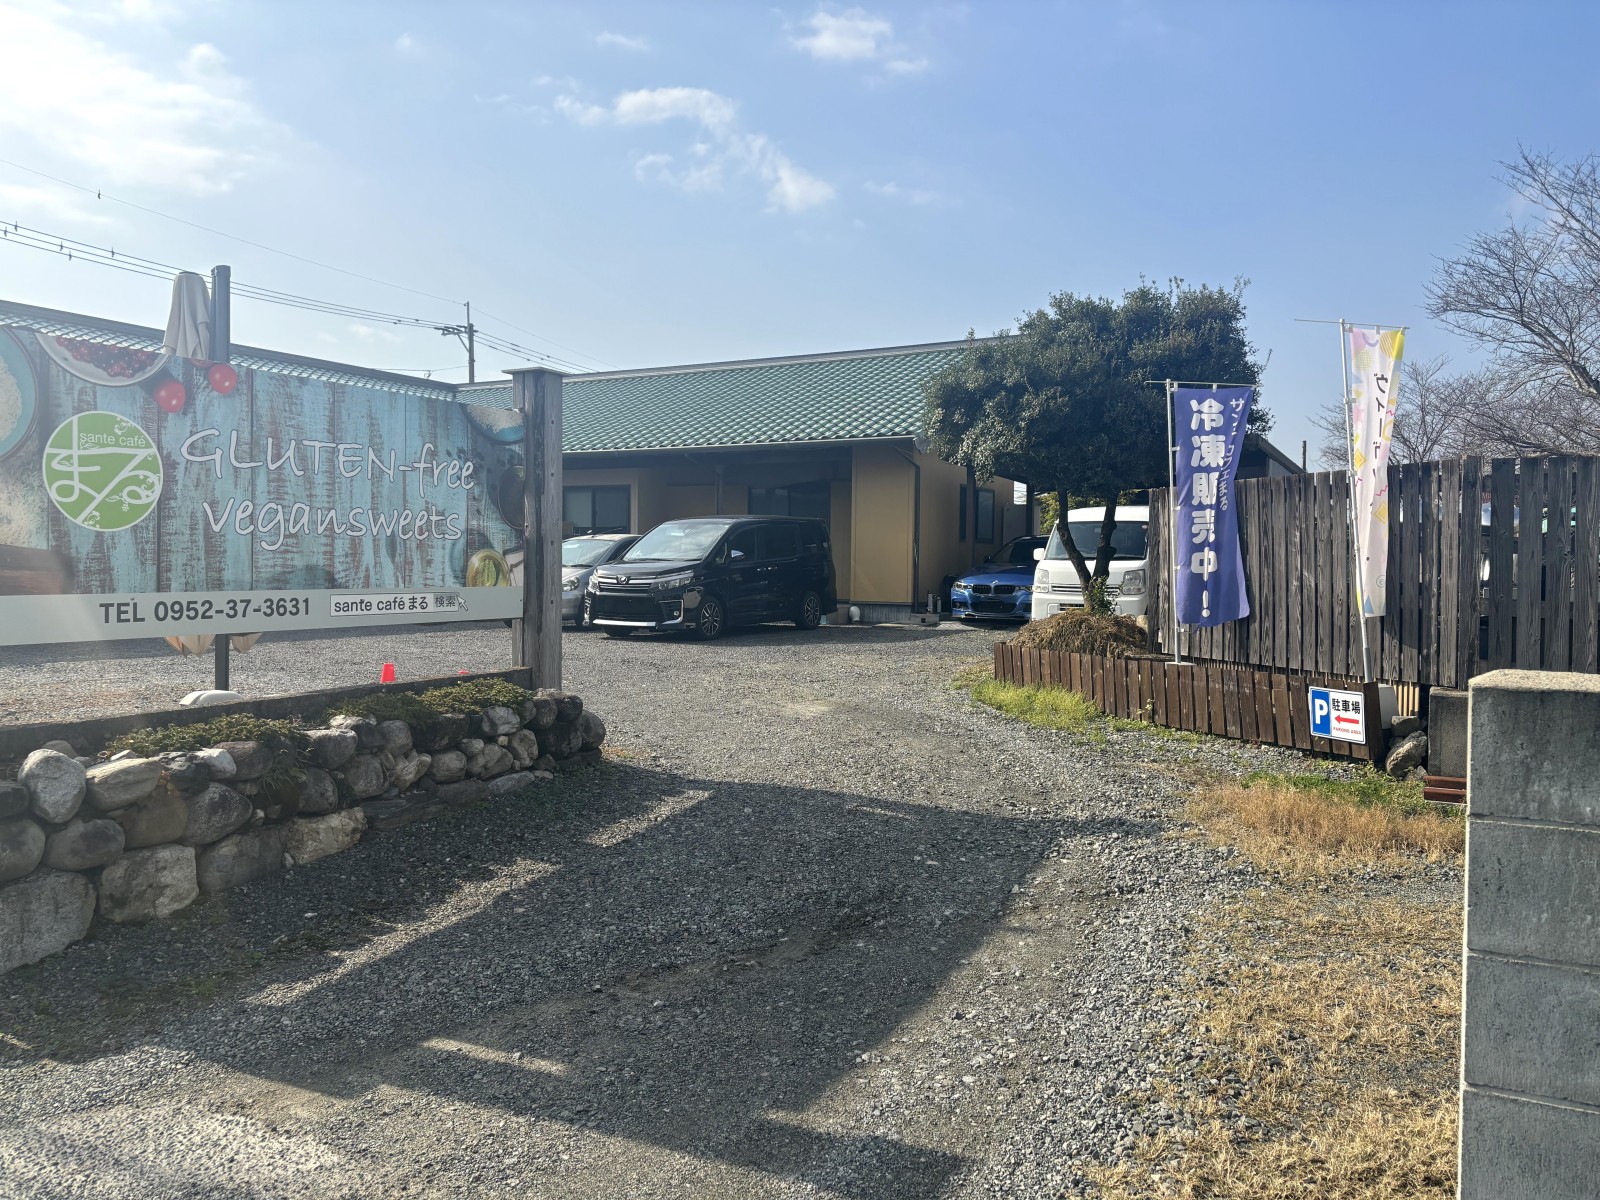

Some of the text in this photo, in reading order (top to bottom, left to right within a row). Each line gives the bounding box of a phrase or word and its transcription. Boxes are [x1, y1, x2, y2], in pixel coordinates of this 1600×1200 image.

[79, 432, 146, 447] sante café
[180, 427, 475, 499] GLUTEN-free
[334, 595, 429, 612] sante café まる
[434, 594, 456, 608] 検索
[99, 596, 310, 624] TEL 0952-37-3631
[1315, 699, 1328, 724] P
[1332, 698, 1360, 714] 駐車場
